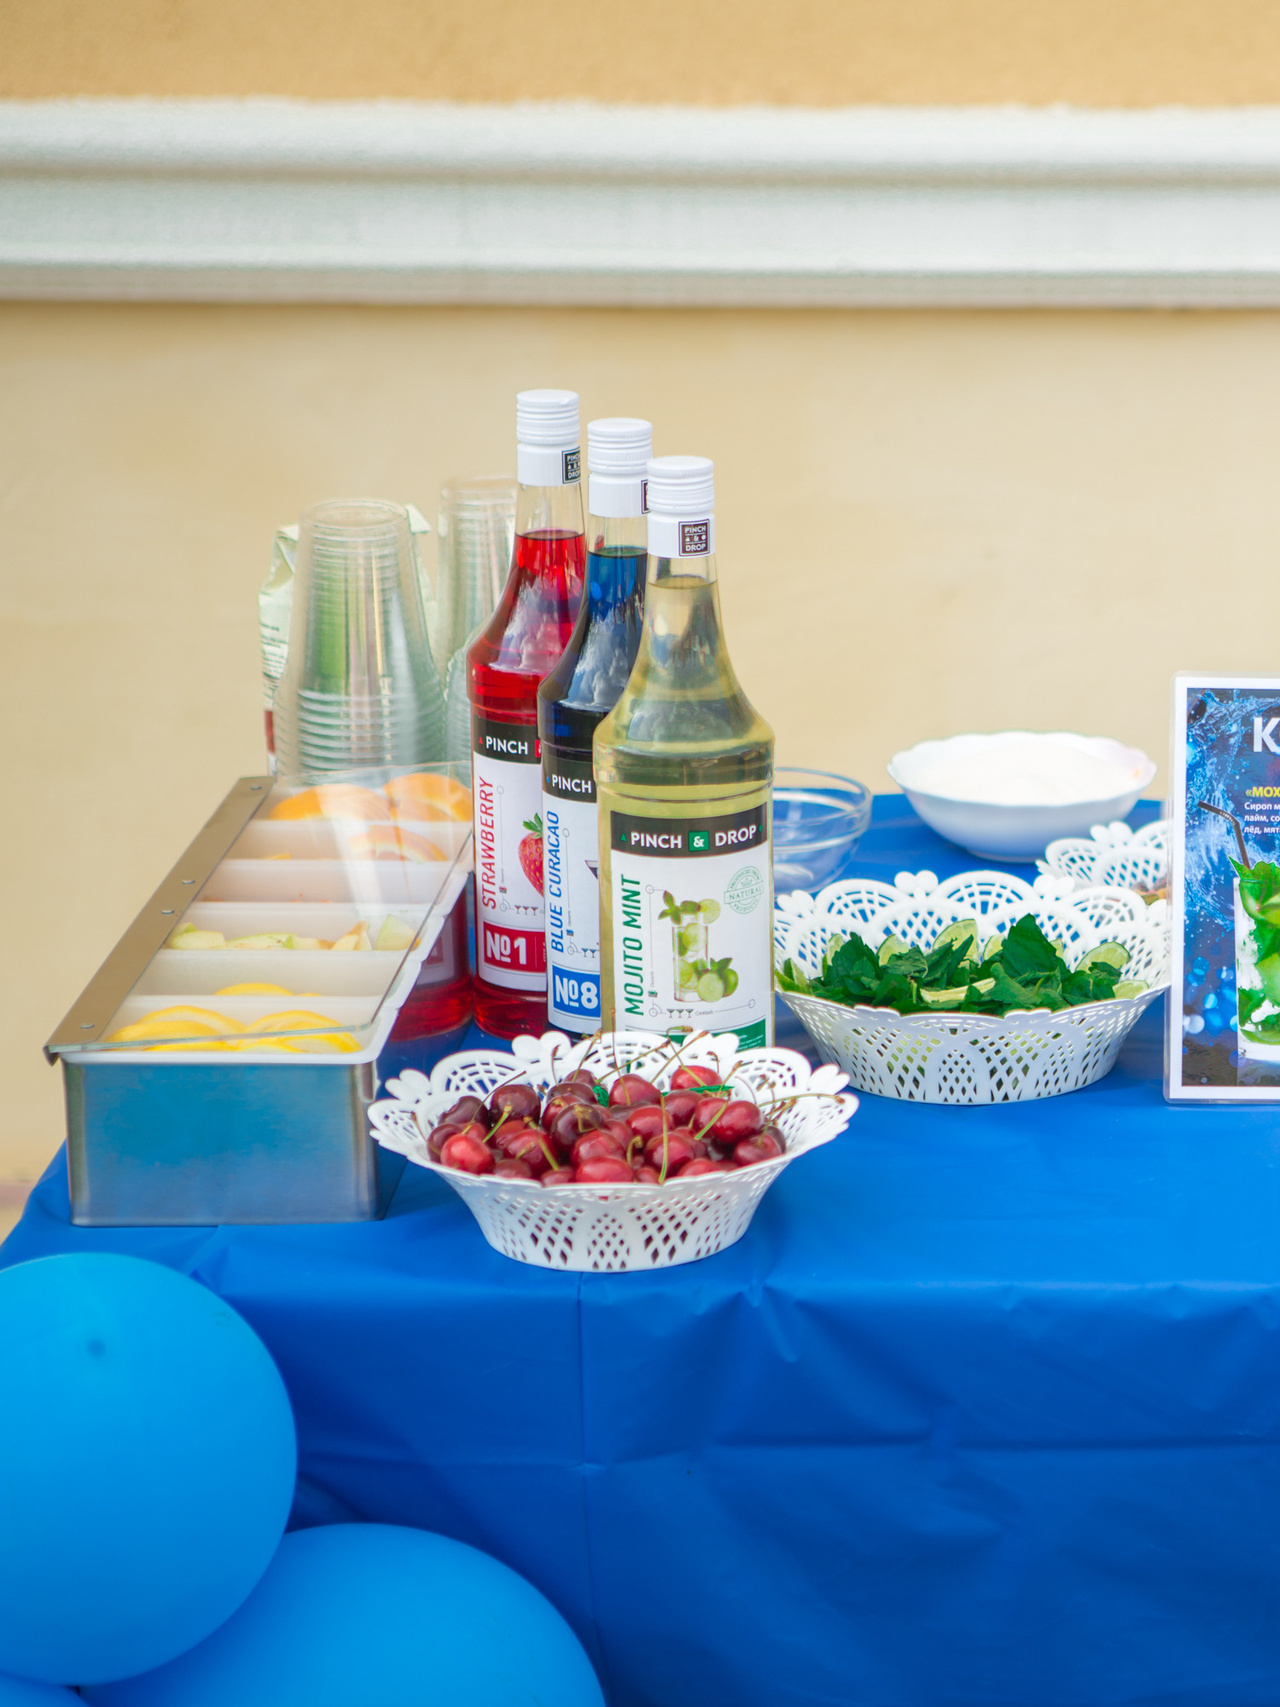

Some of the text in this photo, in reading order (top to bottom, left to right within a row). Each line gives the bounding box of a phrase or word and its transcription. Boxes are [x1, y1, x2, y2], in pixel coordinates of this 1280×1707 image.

[684, 526, 707, 534] PINCH
[685, 543, 707, 552] DROP
[485, 735, 529, 756] PINCH
[551, 774, 592, 794] PINCH
[1244, 801, 1273, 812] Сироп
[1243, 814, 1269, 823] лайм,
[630, 824, 758, 849] PINCH & DROP
[1243, 826, 1262, 835] лёд,
[479, 775, 497, 911] STRAWBERRY
[546, 810, 564, 953] BLUE CURACAO
[621, 874, 644, 1017] MOJITO MINT
